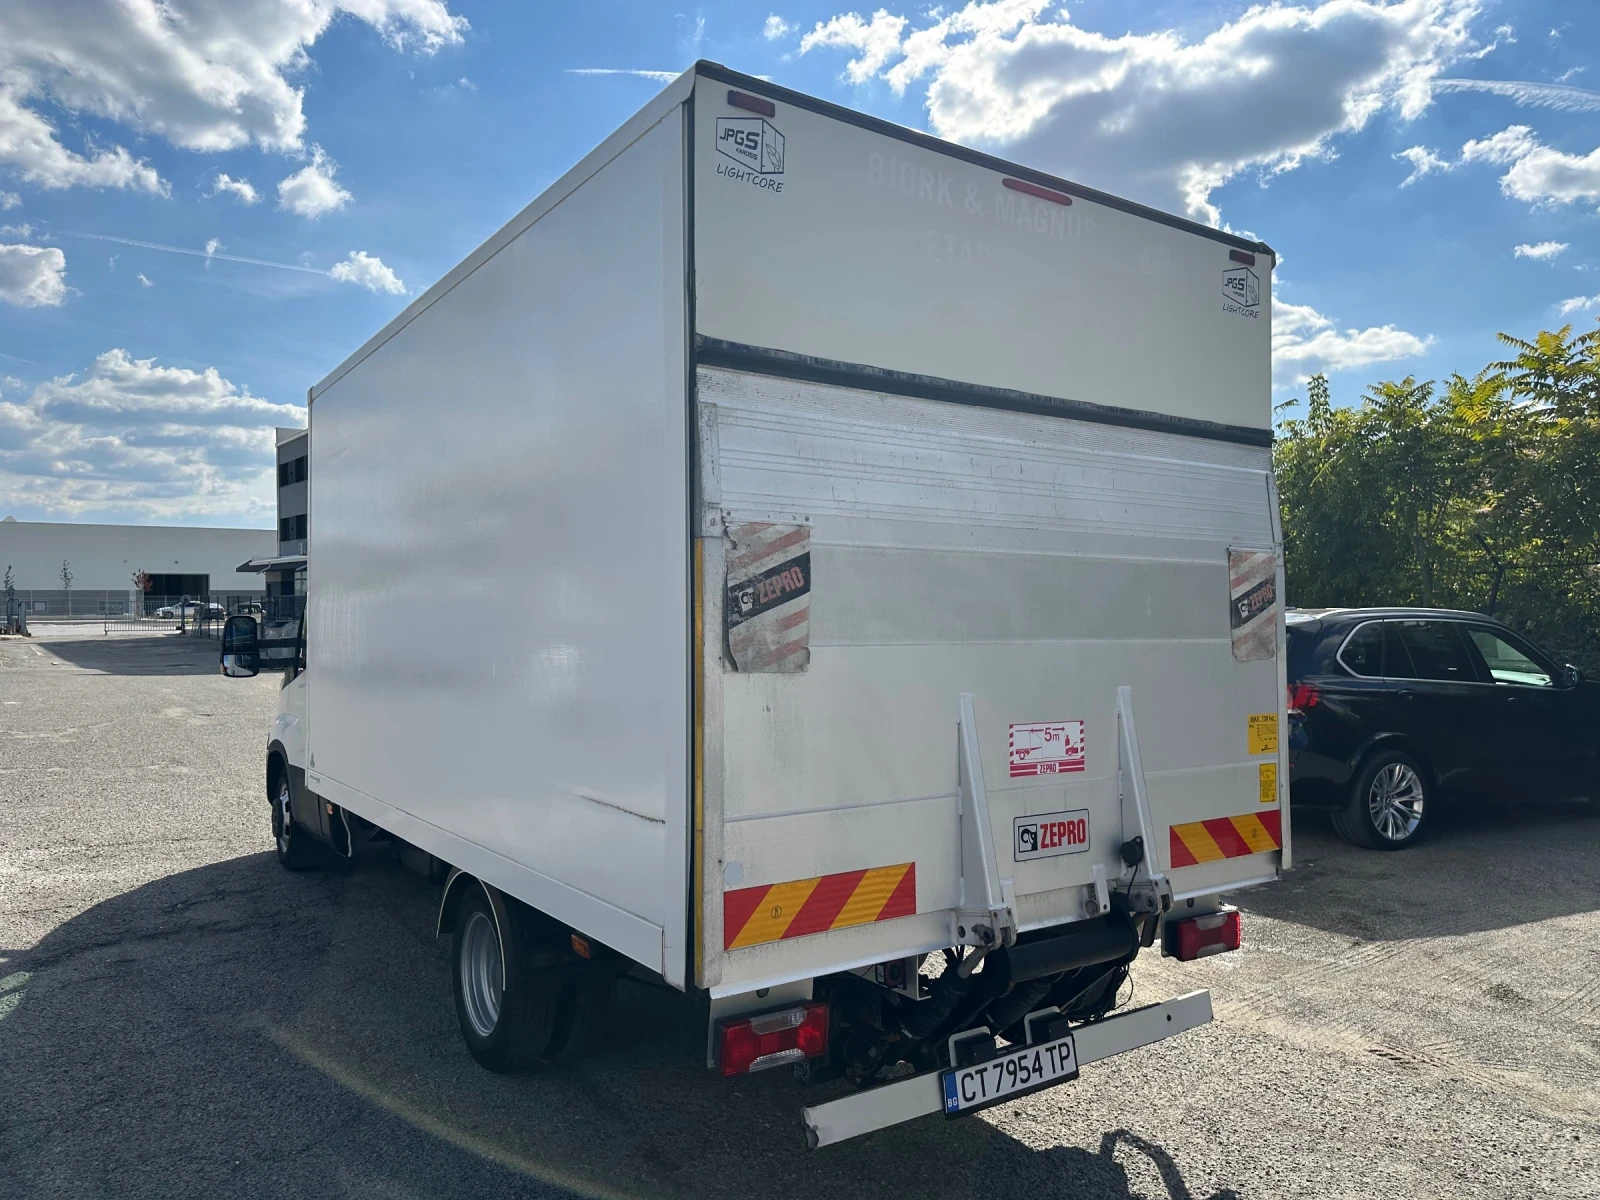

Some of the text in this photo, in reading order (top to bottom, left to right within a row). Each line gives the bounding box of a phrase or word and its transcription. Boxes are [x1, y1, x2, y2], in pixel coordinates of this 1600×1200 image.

[720, 128, 760, 150] JPGS
[717, 163, 784, 192] LIGHTCORE
[1222, 303, 1260, 319] LIGHTCORE
[758, 566, 804, 604] ZEPRO
[1249, 583, 1273, 610] ZEPRO
[1040, 763, 1057, 774] ZEPRO
[1040, 818, 1087, 849] ZEPRO
[961, 1042, 1070, 1102] CT 7954 TP
[947, 1097, 958, 1108] BG
